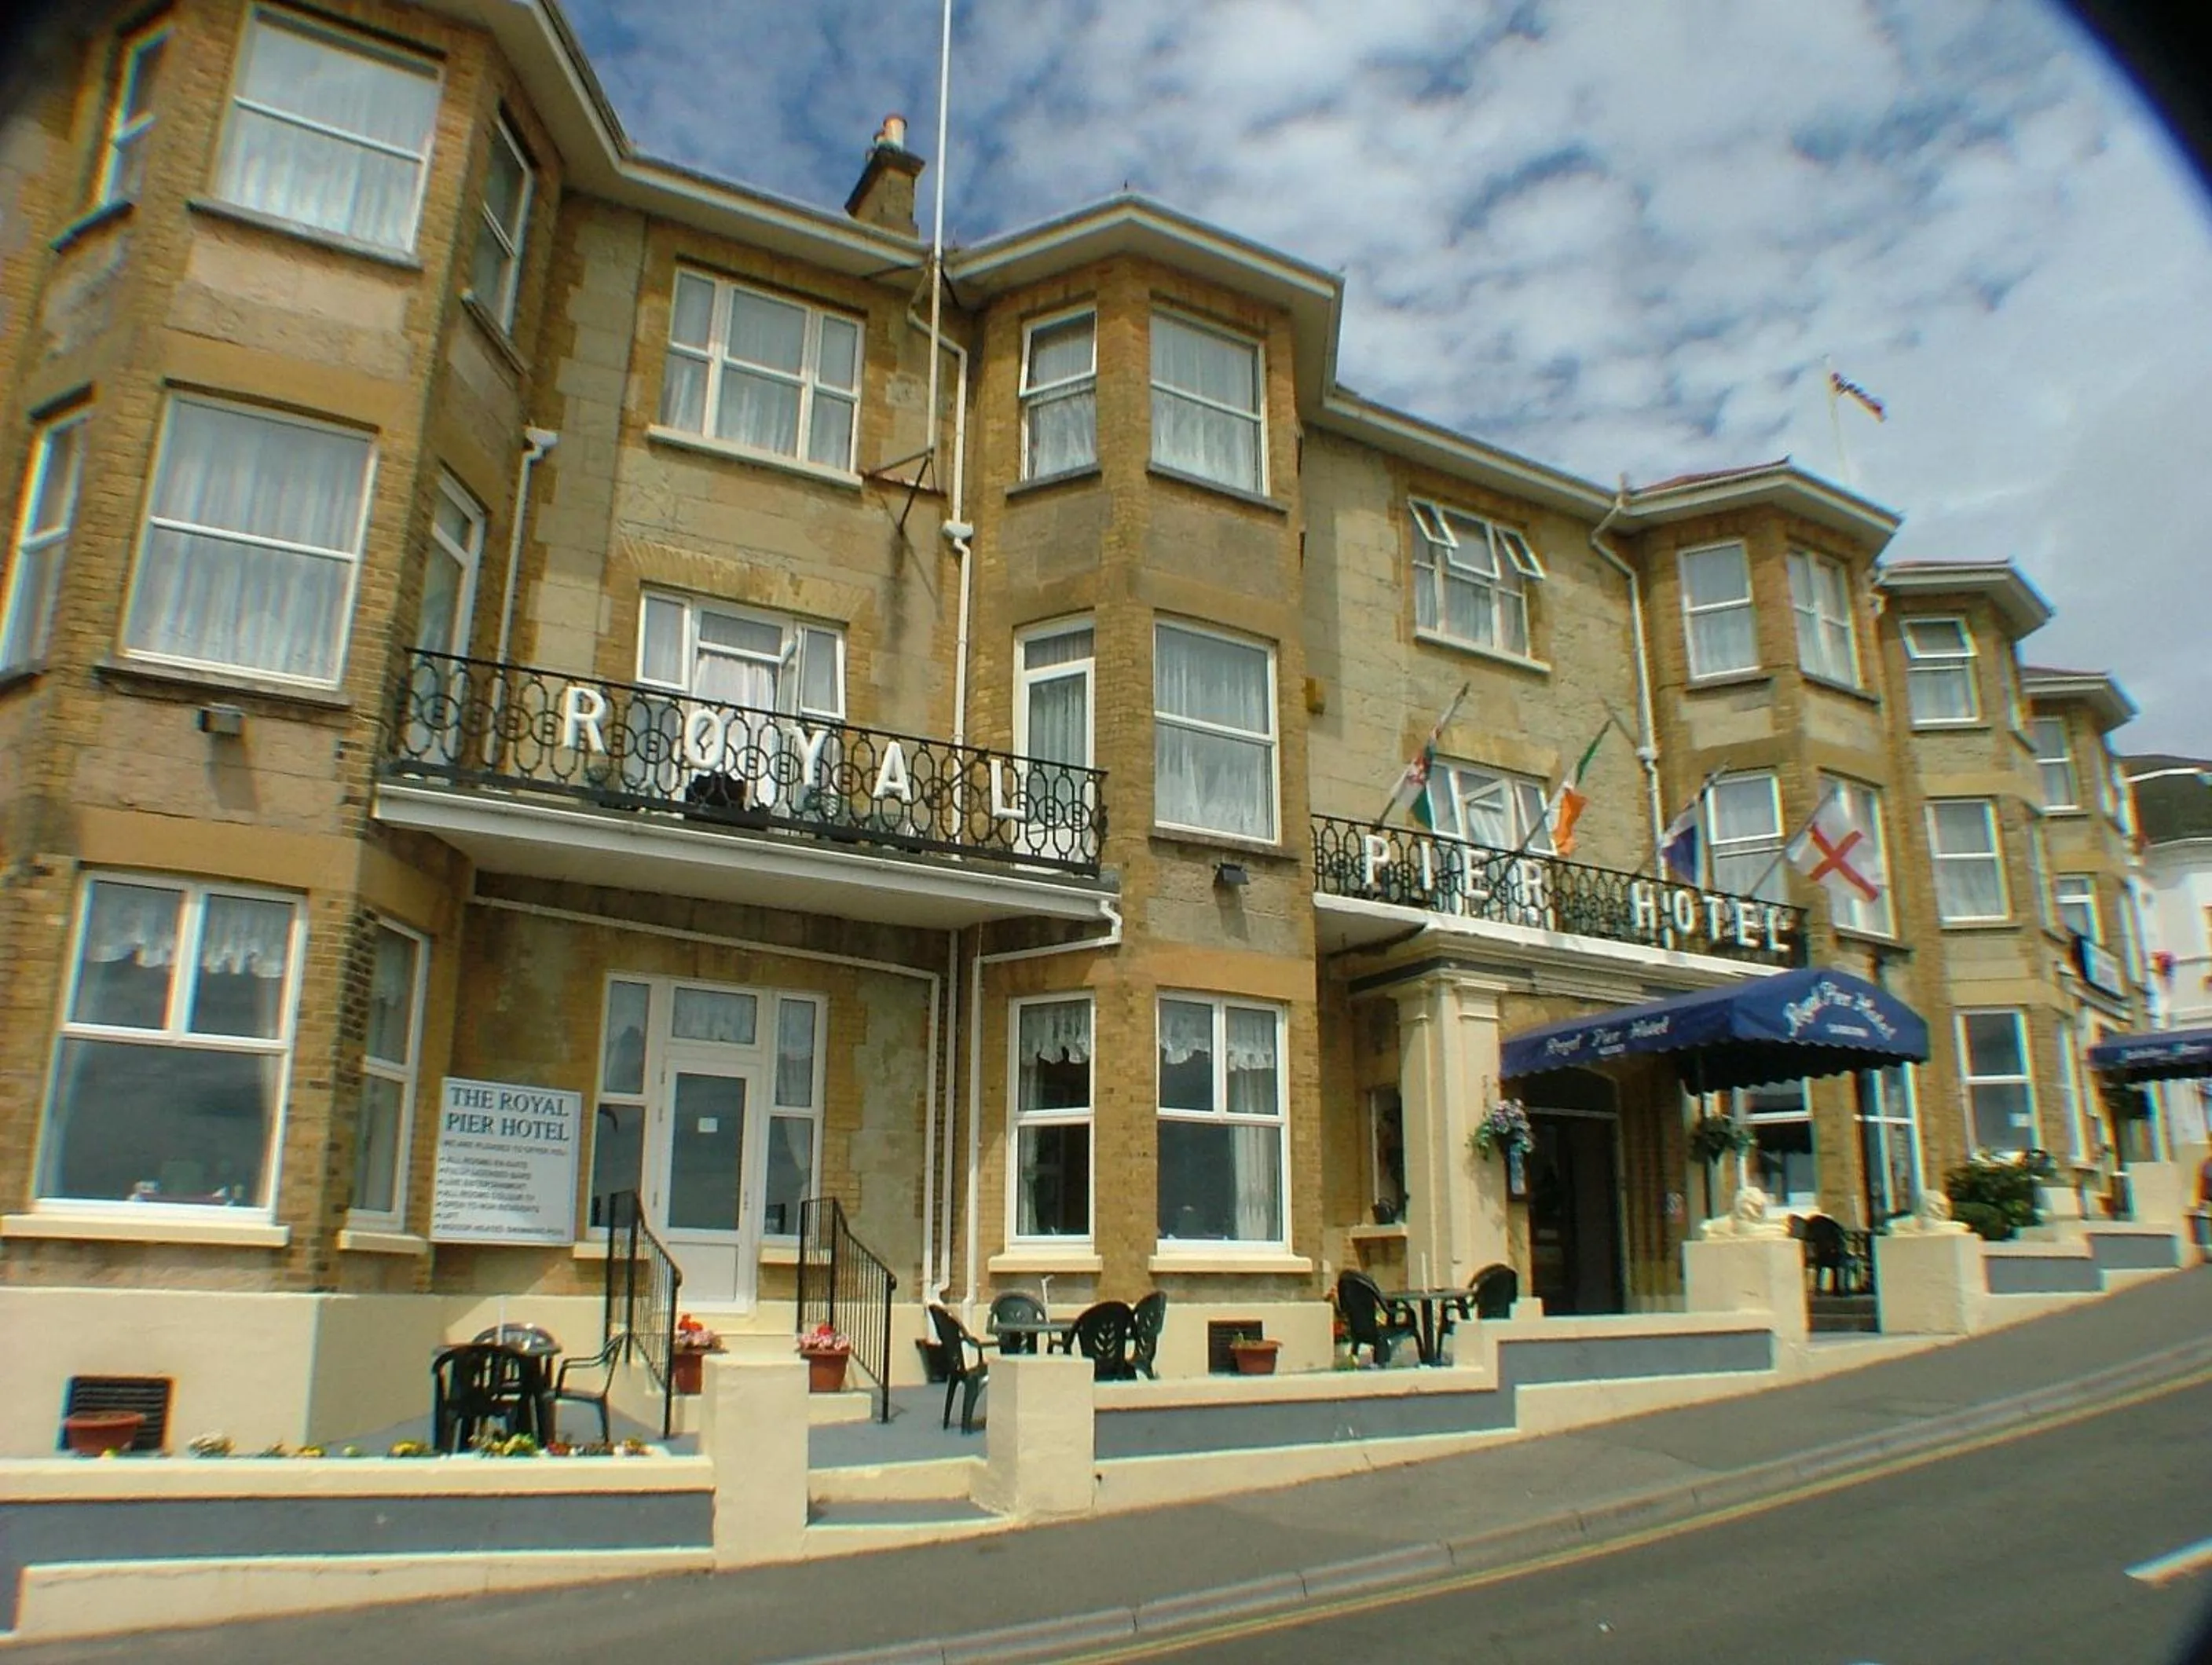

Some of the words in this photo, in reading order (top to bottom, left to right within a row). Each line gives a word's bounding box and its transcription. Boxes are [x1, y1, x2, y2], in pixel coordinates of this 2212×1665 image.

[562, 686, 1025, 819] ROYAL
[1363, 834, 1547, 901] PIER
[1630, 881, 1792, 952] HOTEL
[445, 1112, 495, 1135] PIER
[500, 1117, 569, 1141] HOTEL
[450, 1086, 494, 1110] THE
[498, 1092, 569, 1117] ROYAL
